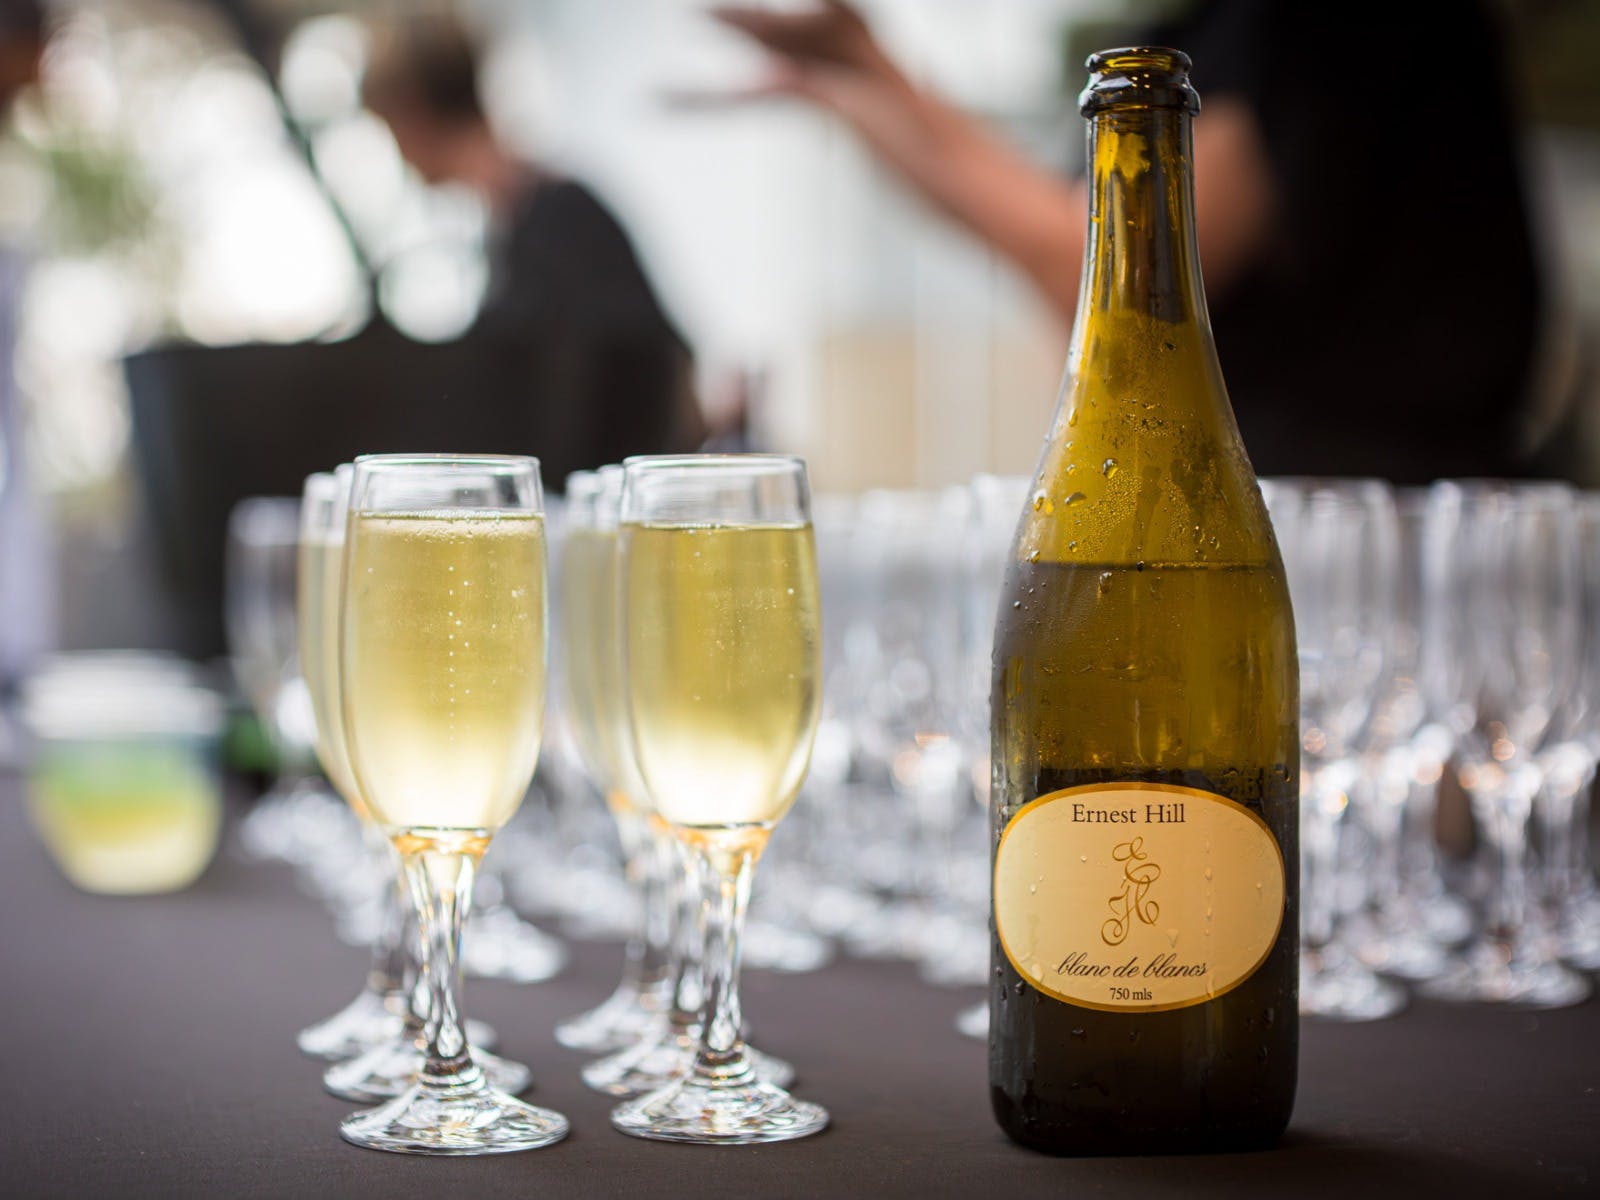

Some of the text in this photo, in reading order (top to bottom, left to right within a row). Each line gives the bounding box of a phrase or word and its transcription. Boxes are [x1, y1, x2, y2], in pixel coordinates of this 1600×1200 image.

[1072, 804, 1186, 823] Ernest Hill
[1057, 952, 1208, 979] blanc de blancs
[1109, 988, 1153, 1001] 750 mls
